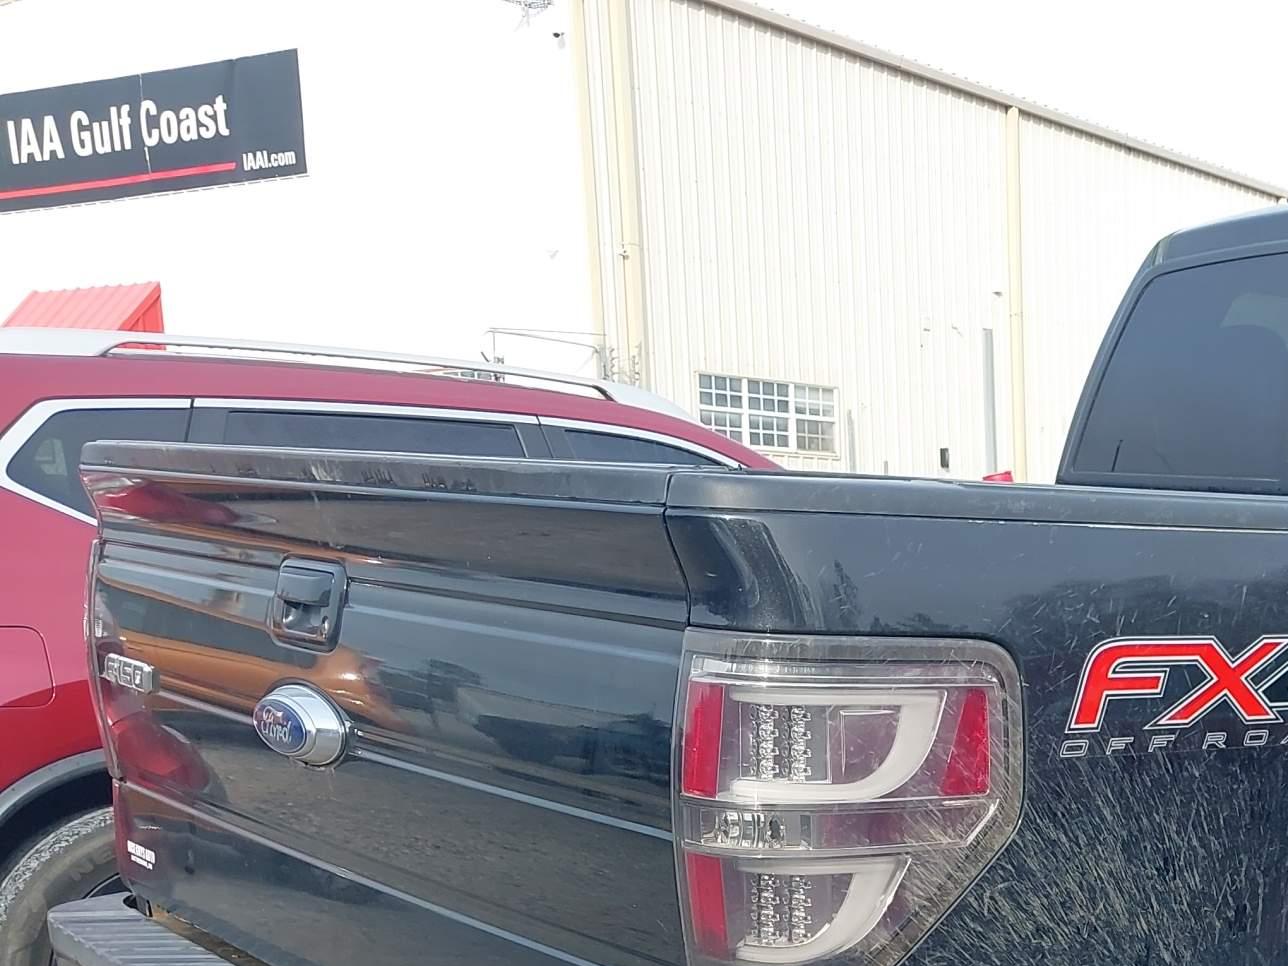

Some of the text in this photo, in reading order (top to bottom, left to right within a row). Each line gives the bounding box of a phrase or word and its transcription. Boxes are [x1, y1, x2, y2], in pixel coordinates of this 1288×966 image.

[7, 94, 230, 165] IAA Gulf Coast
[242, 151, 296, 171] IAAI.com
[1060, 736, 1175, 758] OFF
